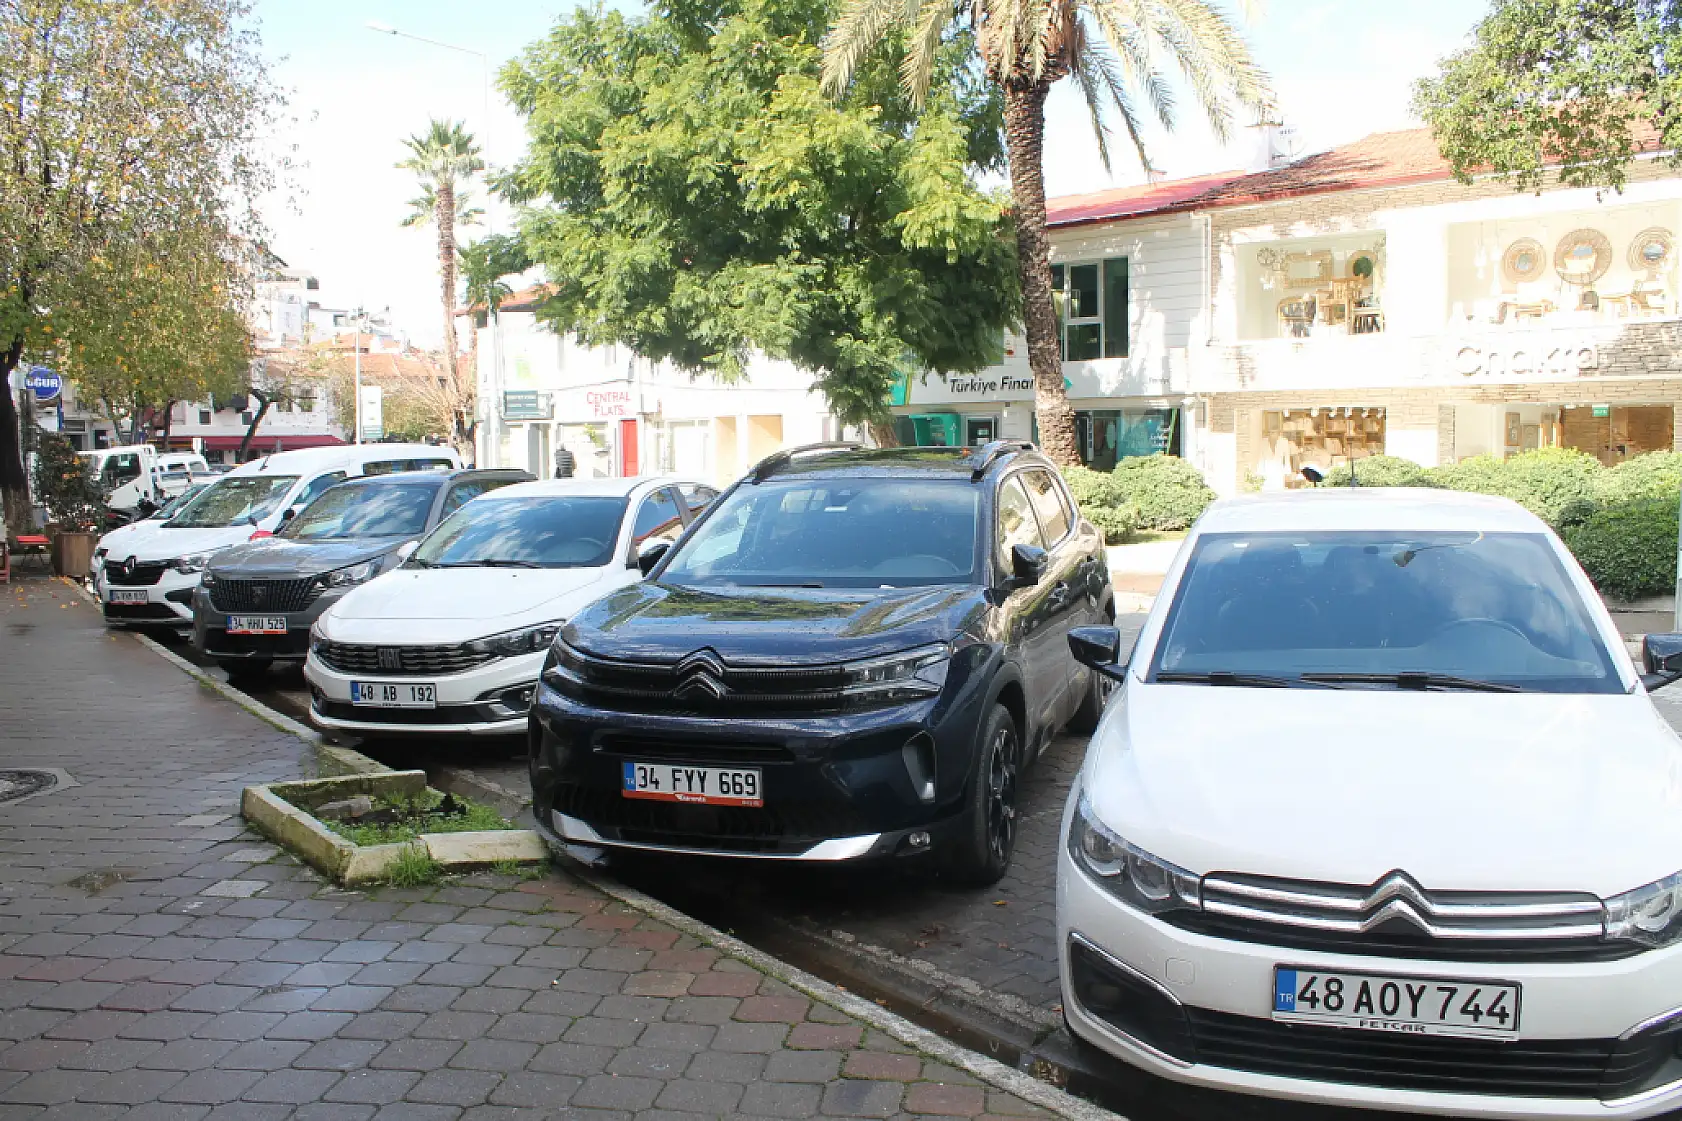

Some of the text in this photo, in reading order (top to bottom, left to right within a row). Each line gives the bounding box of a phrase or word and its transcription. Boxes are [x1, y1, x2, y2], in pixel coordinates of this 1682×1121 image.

[950, 378, 997, 394] Türkiye
[586, 391, 631, 404] CENTRAL
[594, 405, 625, 418] FLATS
[267, 618, 284, 629] 529
[361, 684, 434, 702] 48 AB 192
[637, 766, 660, 790] 34
[671, 768, 707, 793] FYY
[719, 772, 756, 796] 669
[1279, 975, 1510, 1026] TR 48 AOY 744
